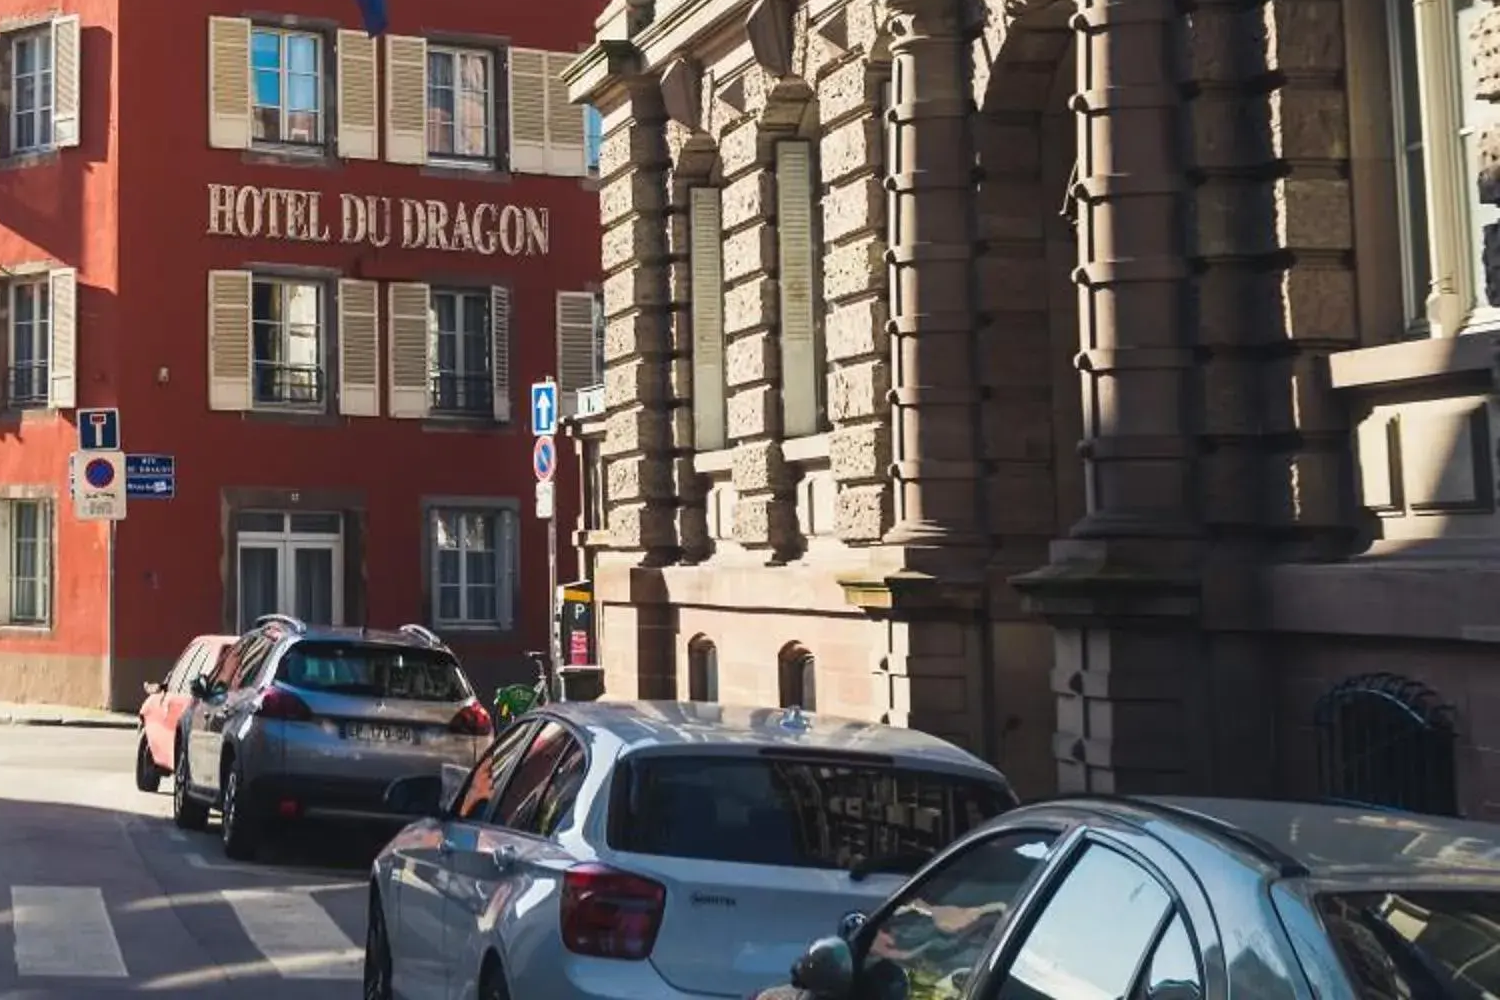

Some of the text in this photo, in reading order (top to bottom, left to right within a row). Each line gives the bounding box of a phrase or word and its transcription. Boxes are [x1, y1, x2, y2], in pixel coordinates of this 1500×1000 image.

[206, 183, 549, 255] HOTEL DU DRAGON
